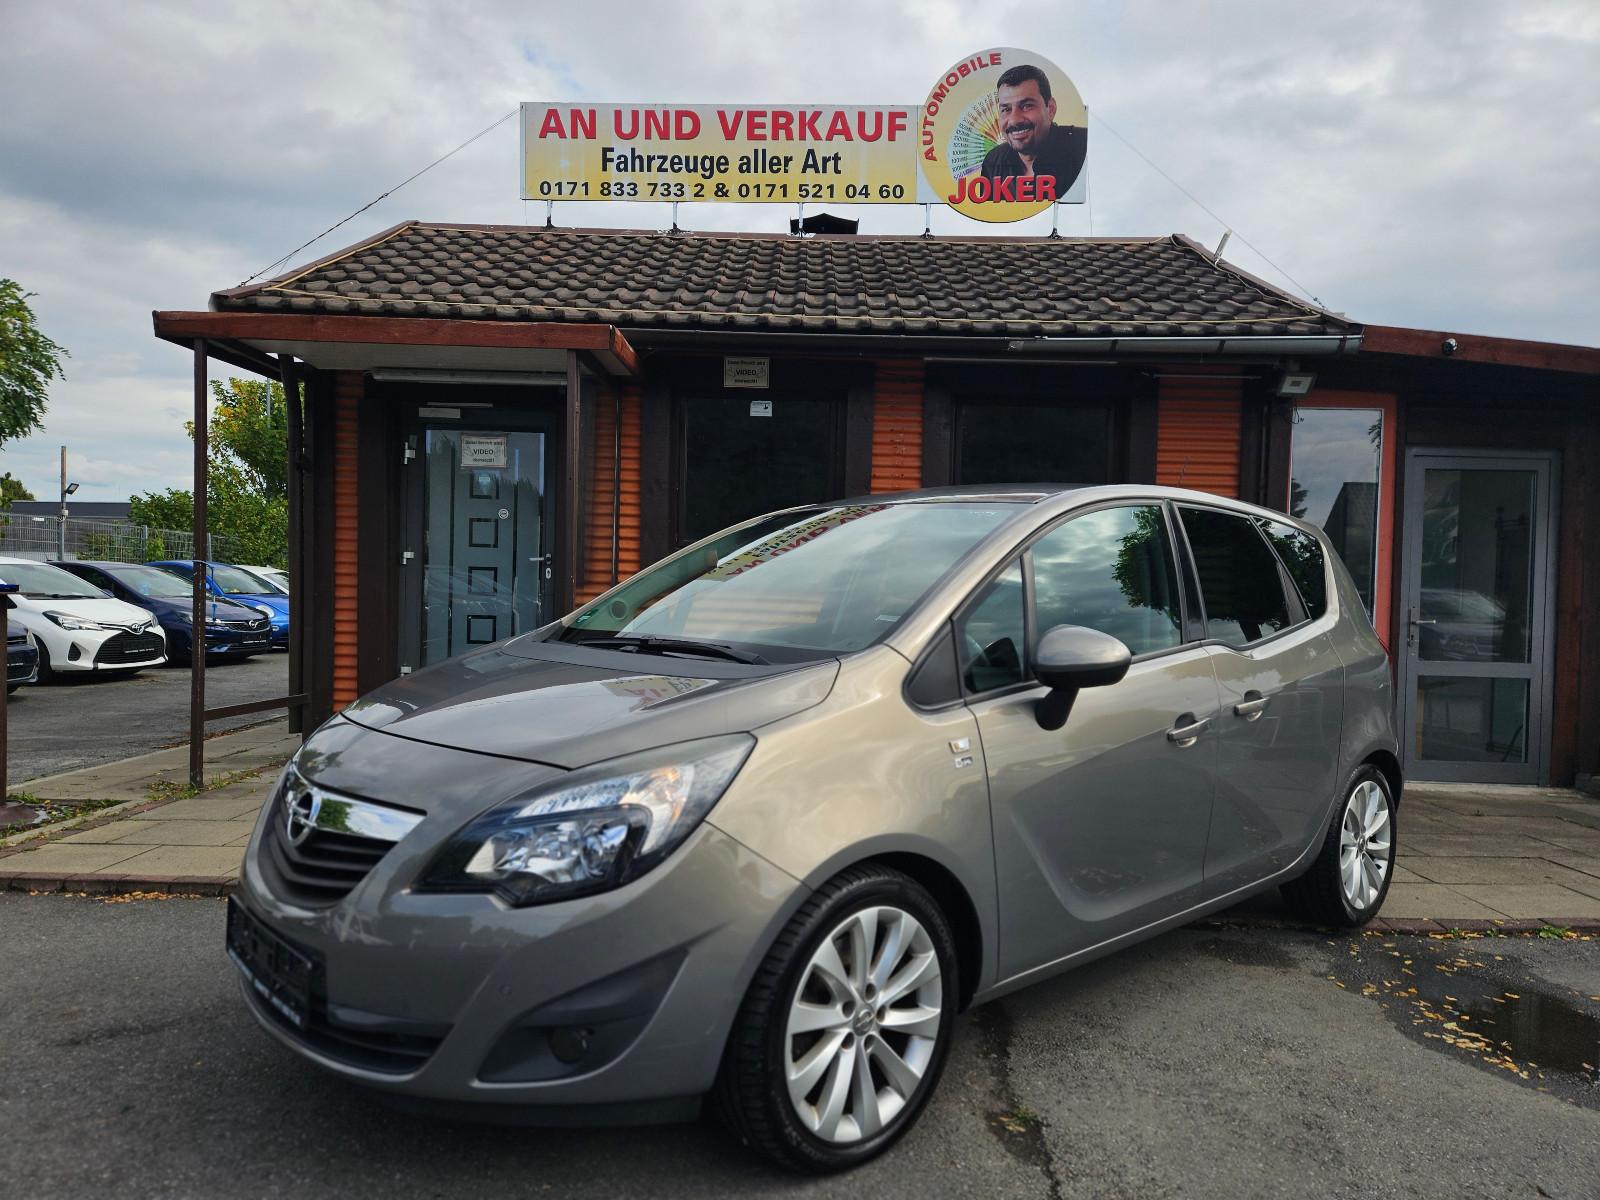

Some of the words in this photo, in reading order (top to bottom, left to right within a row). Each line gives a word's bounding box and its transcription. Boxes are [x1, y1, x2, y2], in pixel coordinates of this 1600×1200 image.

[923, 52, 1002, 162] AUTOMOBILE
[538, 108, 597, 140] AN
[613, 109, 701, 141] UND
[716, 110, 908, 143] VERKAUF
[601, 147, 730, 180] Fahrzeuge
[738, 148, 793, 174] aller
[801, 148, 842, 175] Art
[539, 181, 590, 196] 0171
[600, 181, 639, 197] 833
[647, 182, 685, 198] 733
[693, 182, 705, 198] 2
[713, 182, 730, 198] &
[738, 183, 788, 198] 0171
[798, 183, 836, 199] 521
[845, 183, 871, 199] 04
[878, 184, 905, 199] 60
[947, 174, 1058, 205] JOKER
[735, 368, 758, 376] VIDEO
